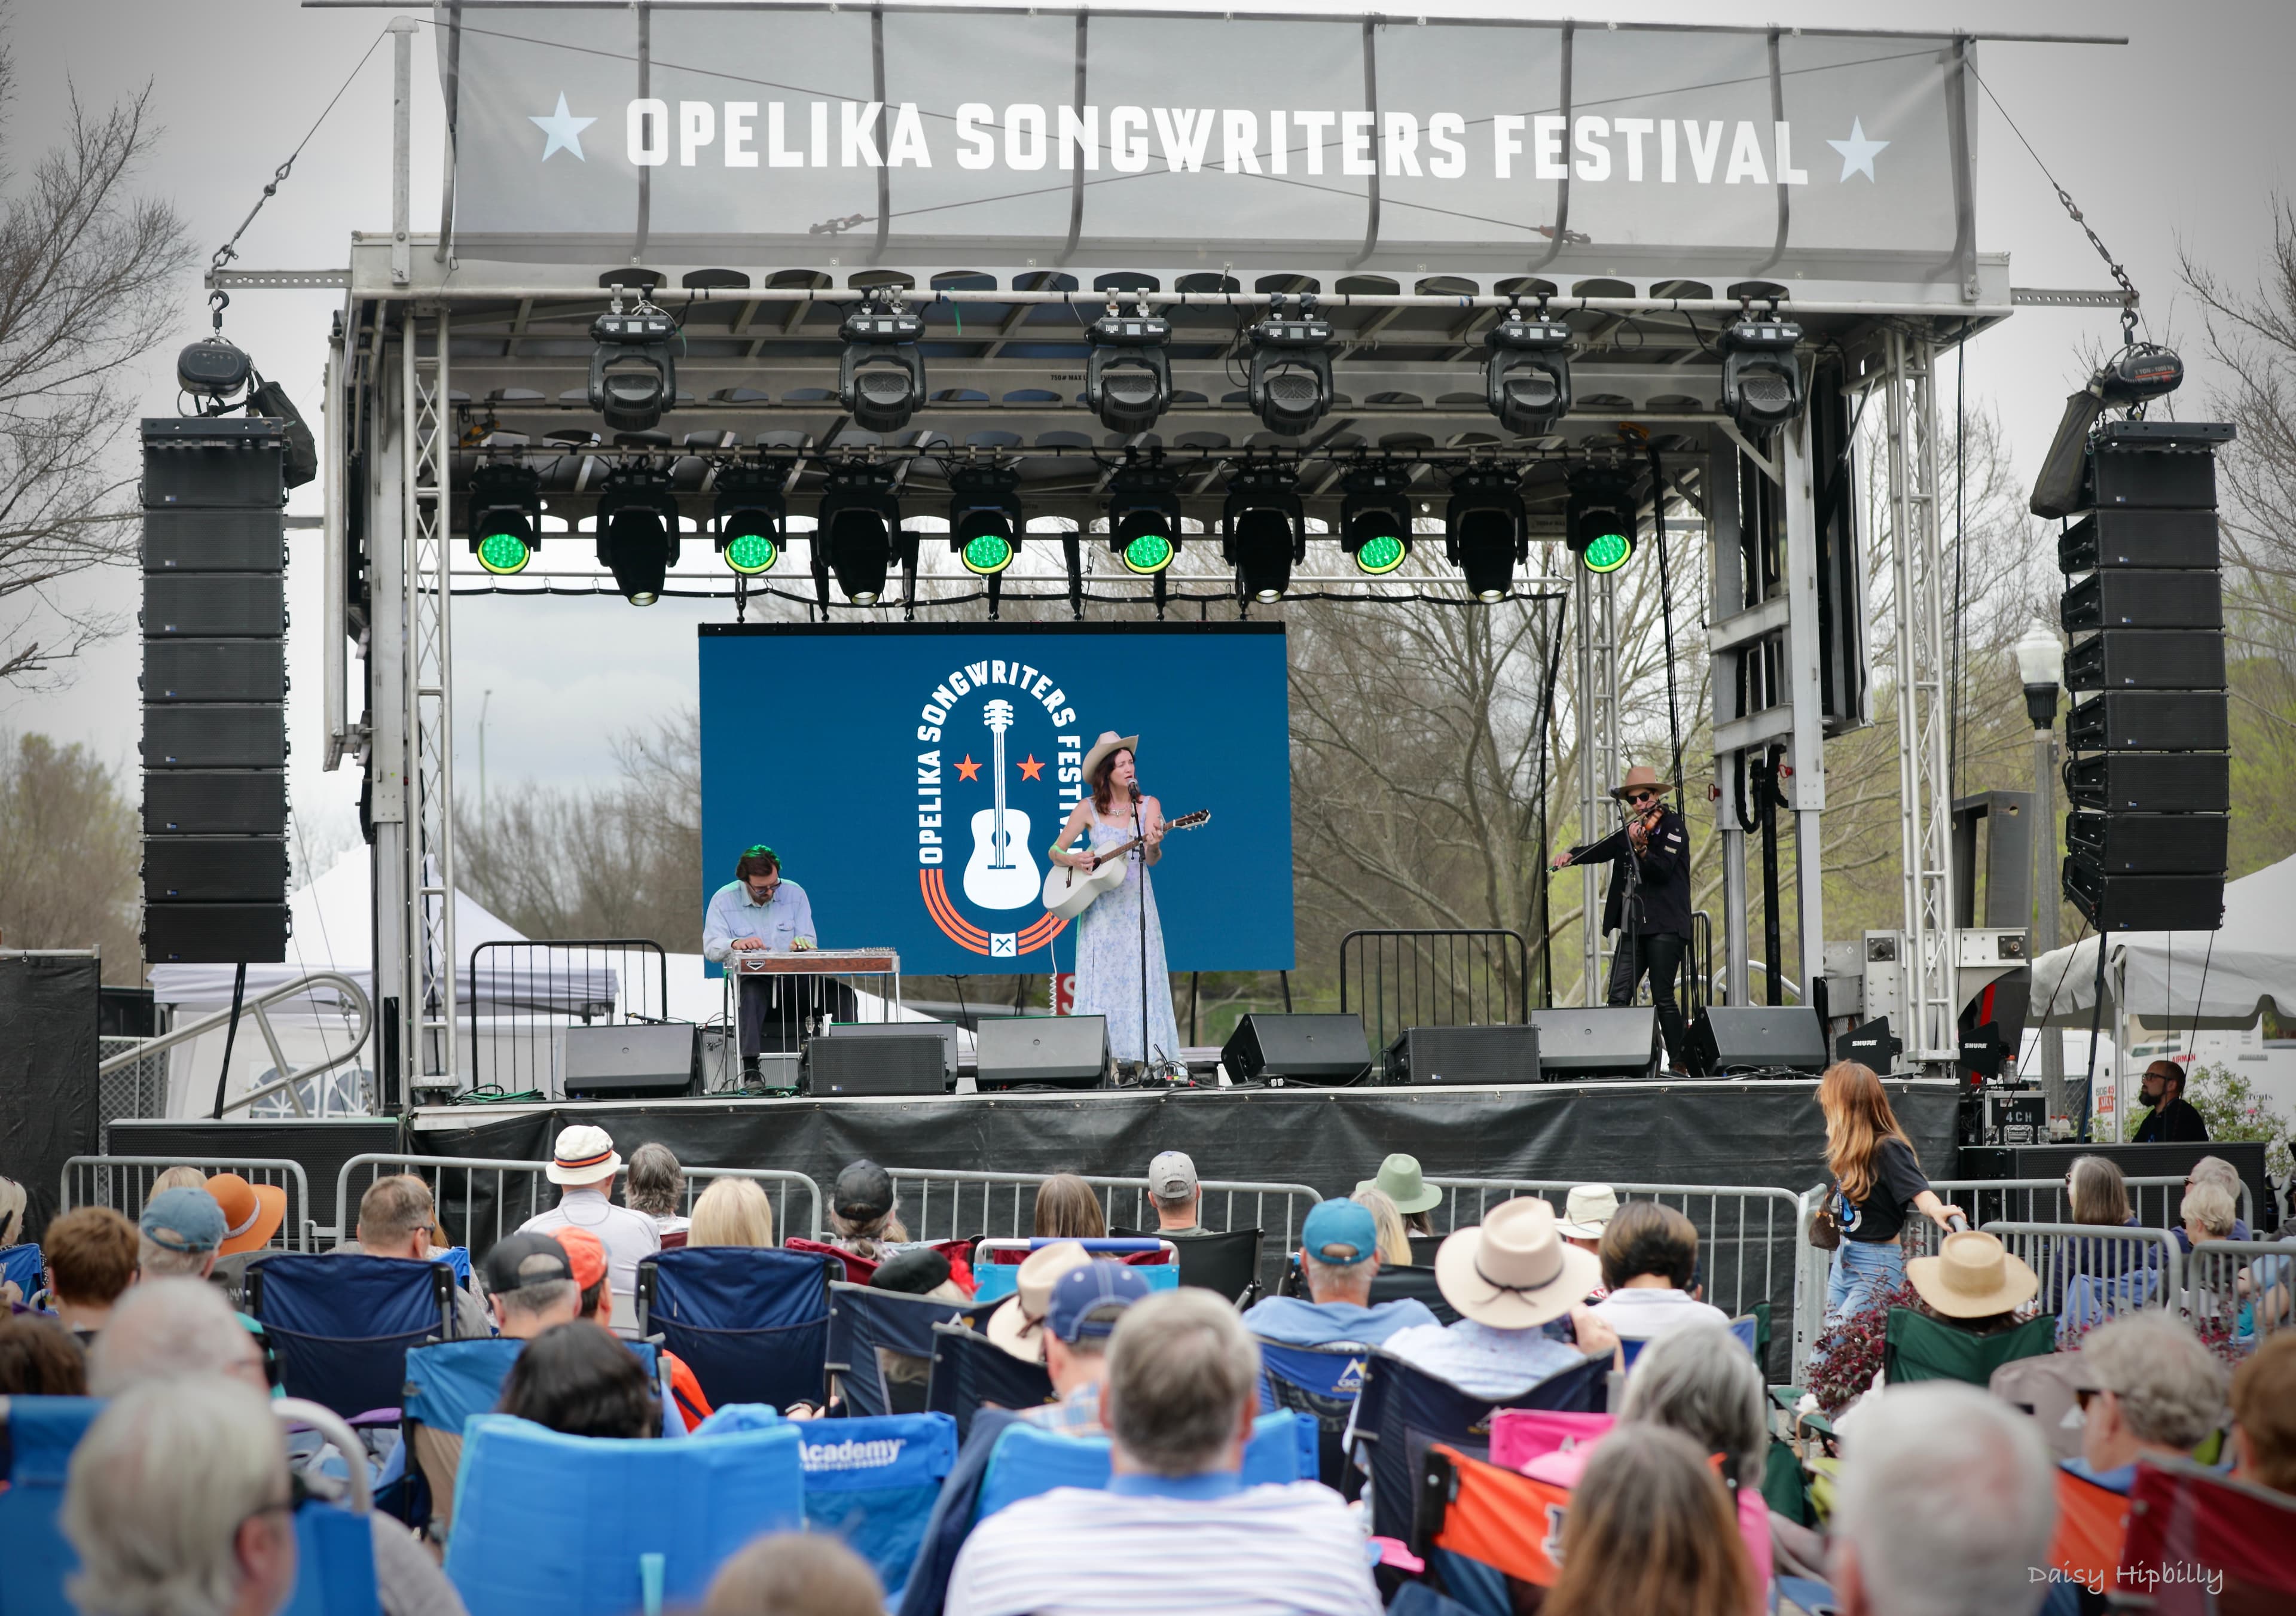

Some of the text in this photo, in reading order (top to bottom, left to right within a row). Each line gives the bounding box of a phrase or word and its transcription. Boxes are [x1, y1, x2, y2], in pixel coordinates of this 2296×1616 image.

[627, 99, 1808, 185] OPELIKA SONGWRITERS FESTIVAL
[917, 660, 1076, 743] SONGWRITERS
[917, 749, 943, 864] OPELIKA
[2172, 1053, 2196, 1063] AIRMAN
